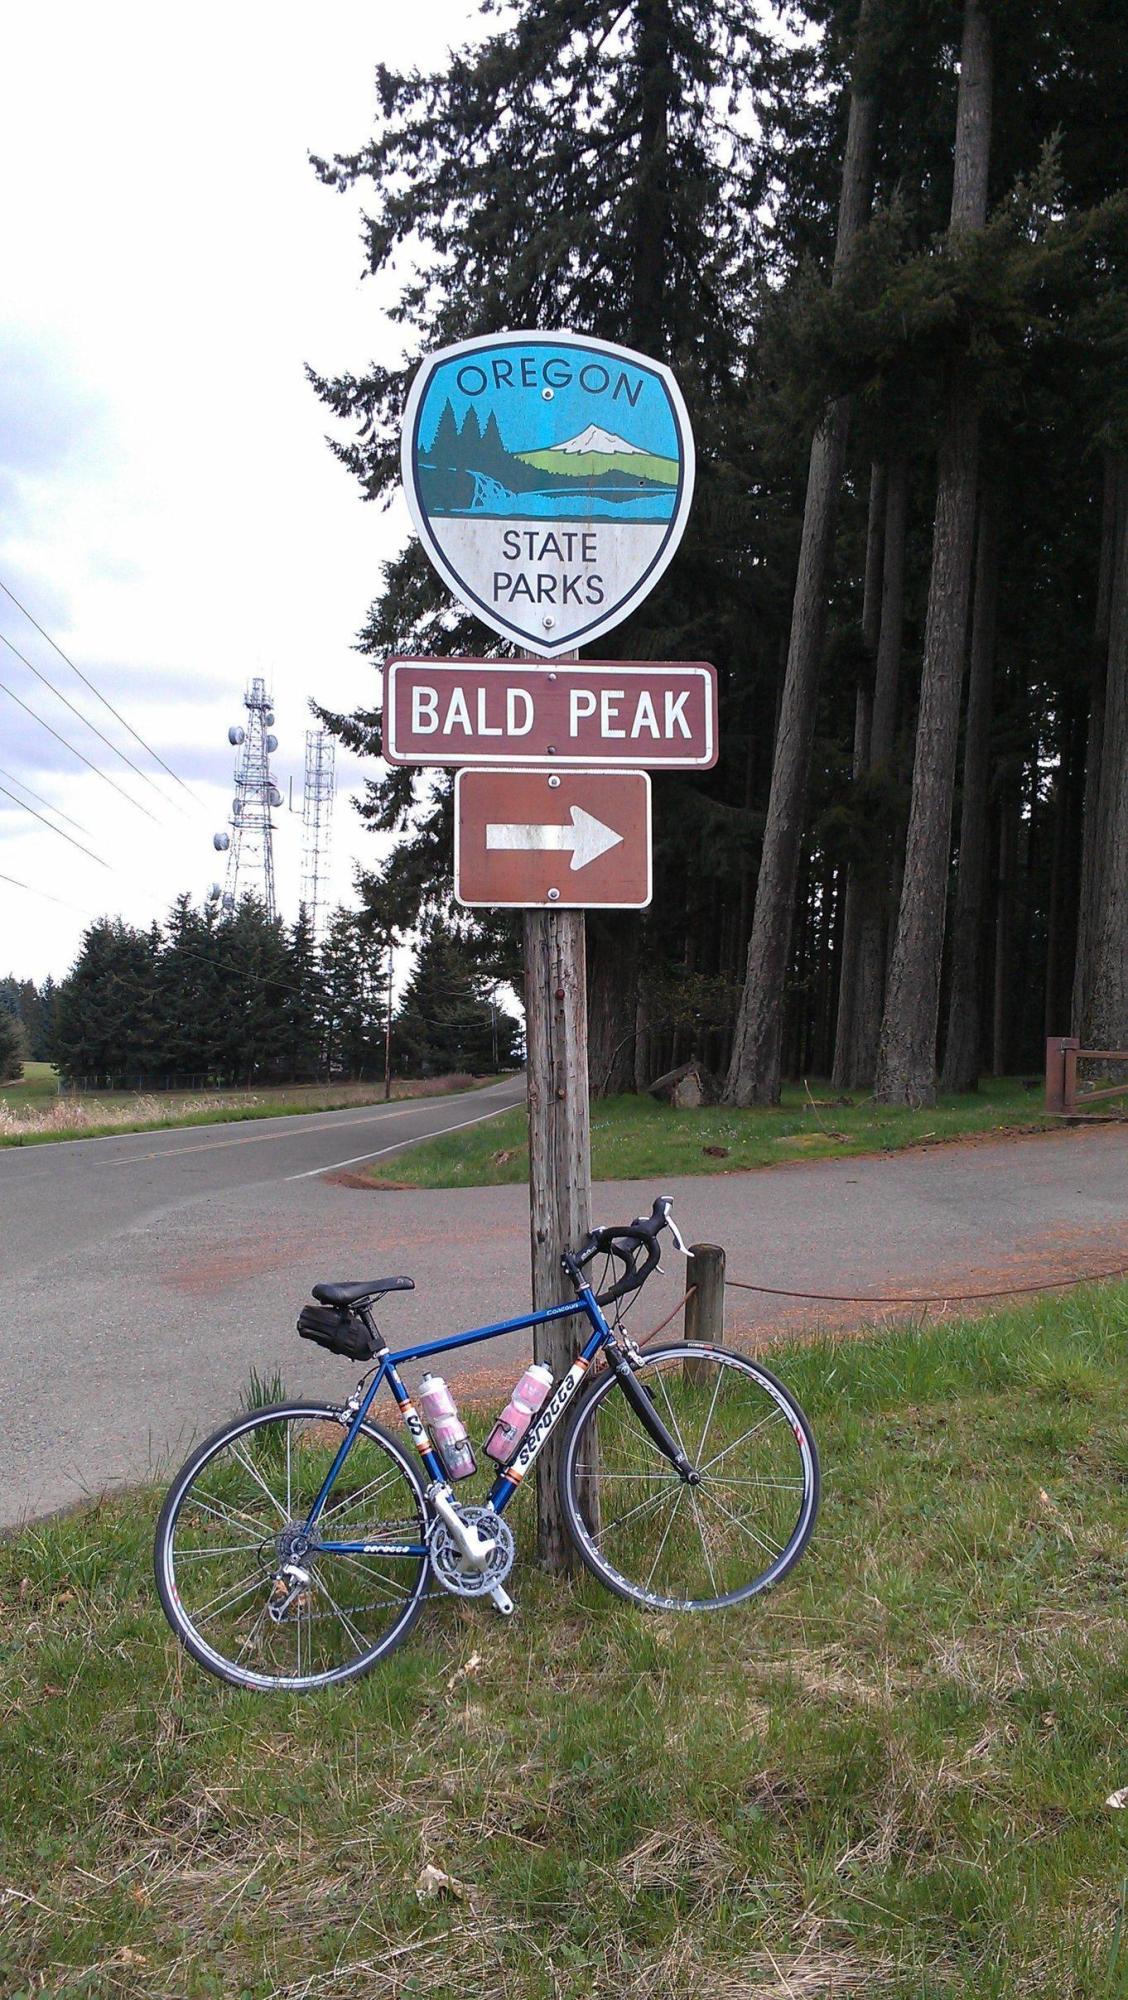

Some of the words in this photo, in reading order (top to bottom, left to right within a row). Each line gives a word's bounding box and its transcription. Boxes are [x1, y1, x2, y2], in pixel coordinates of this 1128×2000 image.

[456, 357, 644, 407] OREGON
[502, 529, 597, 563] STATE
[493, 571, 605, 605] PARKS
[411, 685, 535, 736] BALD
[568, 689, 692, 739] PEAK
